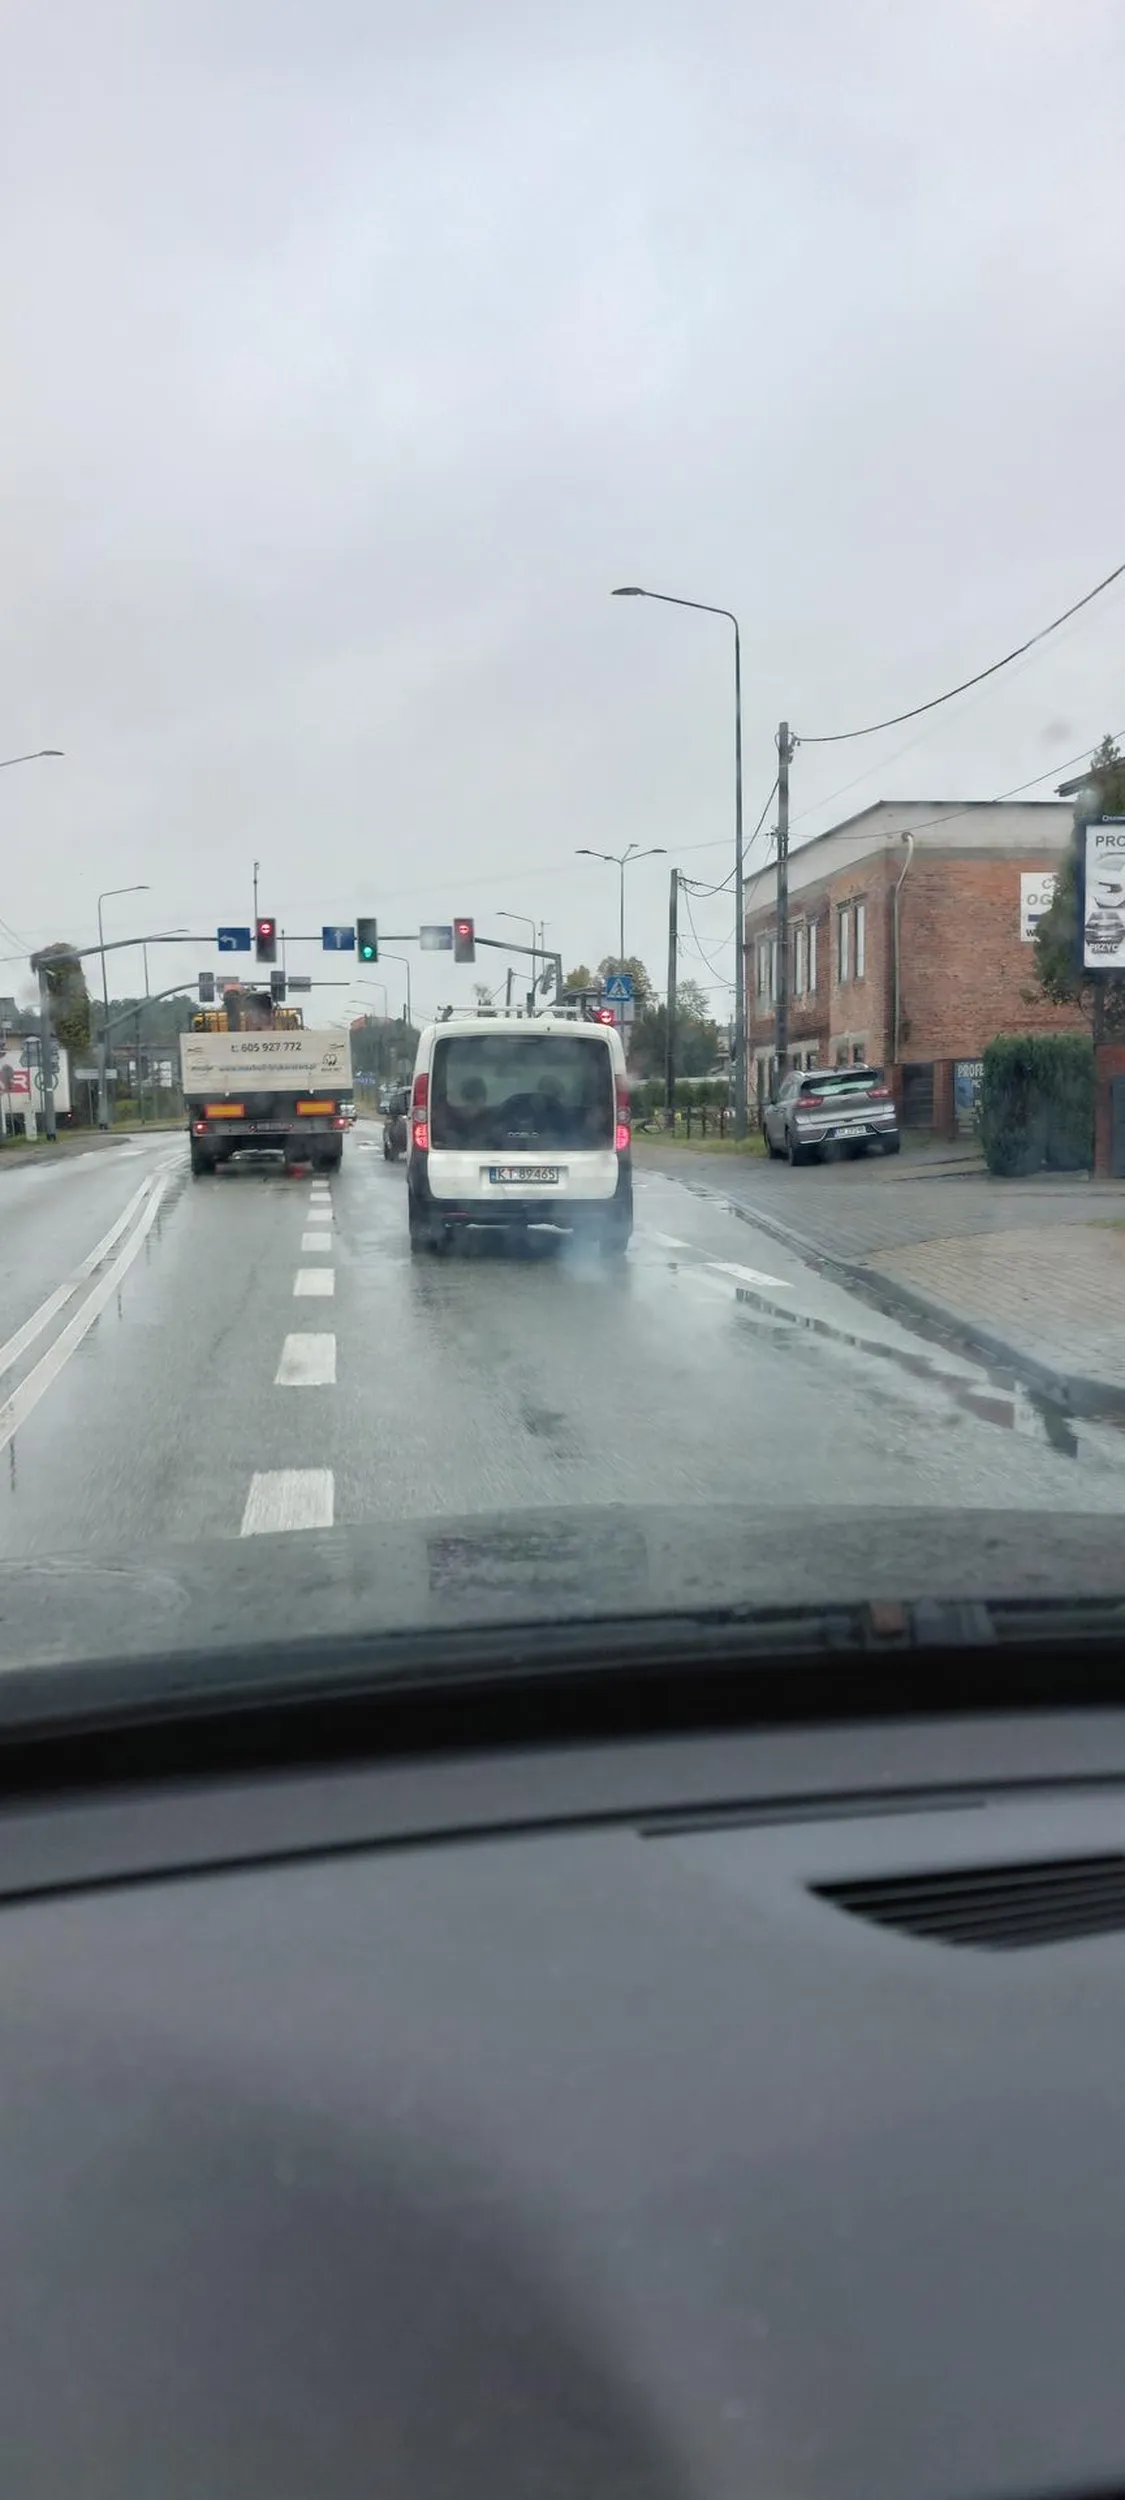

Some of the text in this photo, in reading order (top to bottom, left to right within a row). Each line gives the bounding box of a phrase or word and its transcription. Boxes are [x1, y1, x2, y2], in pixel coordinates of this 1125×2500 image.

[241, 1042, 260, 1053] 605
[262, 1042, 280, 1052] 927
[283, 1041, 302, 1051] 772
[498, 1167, 514, 1179] KT
